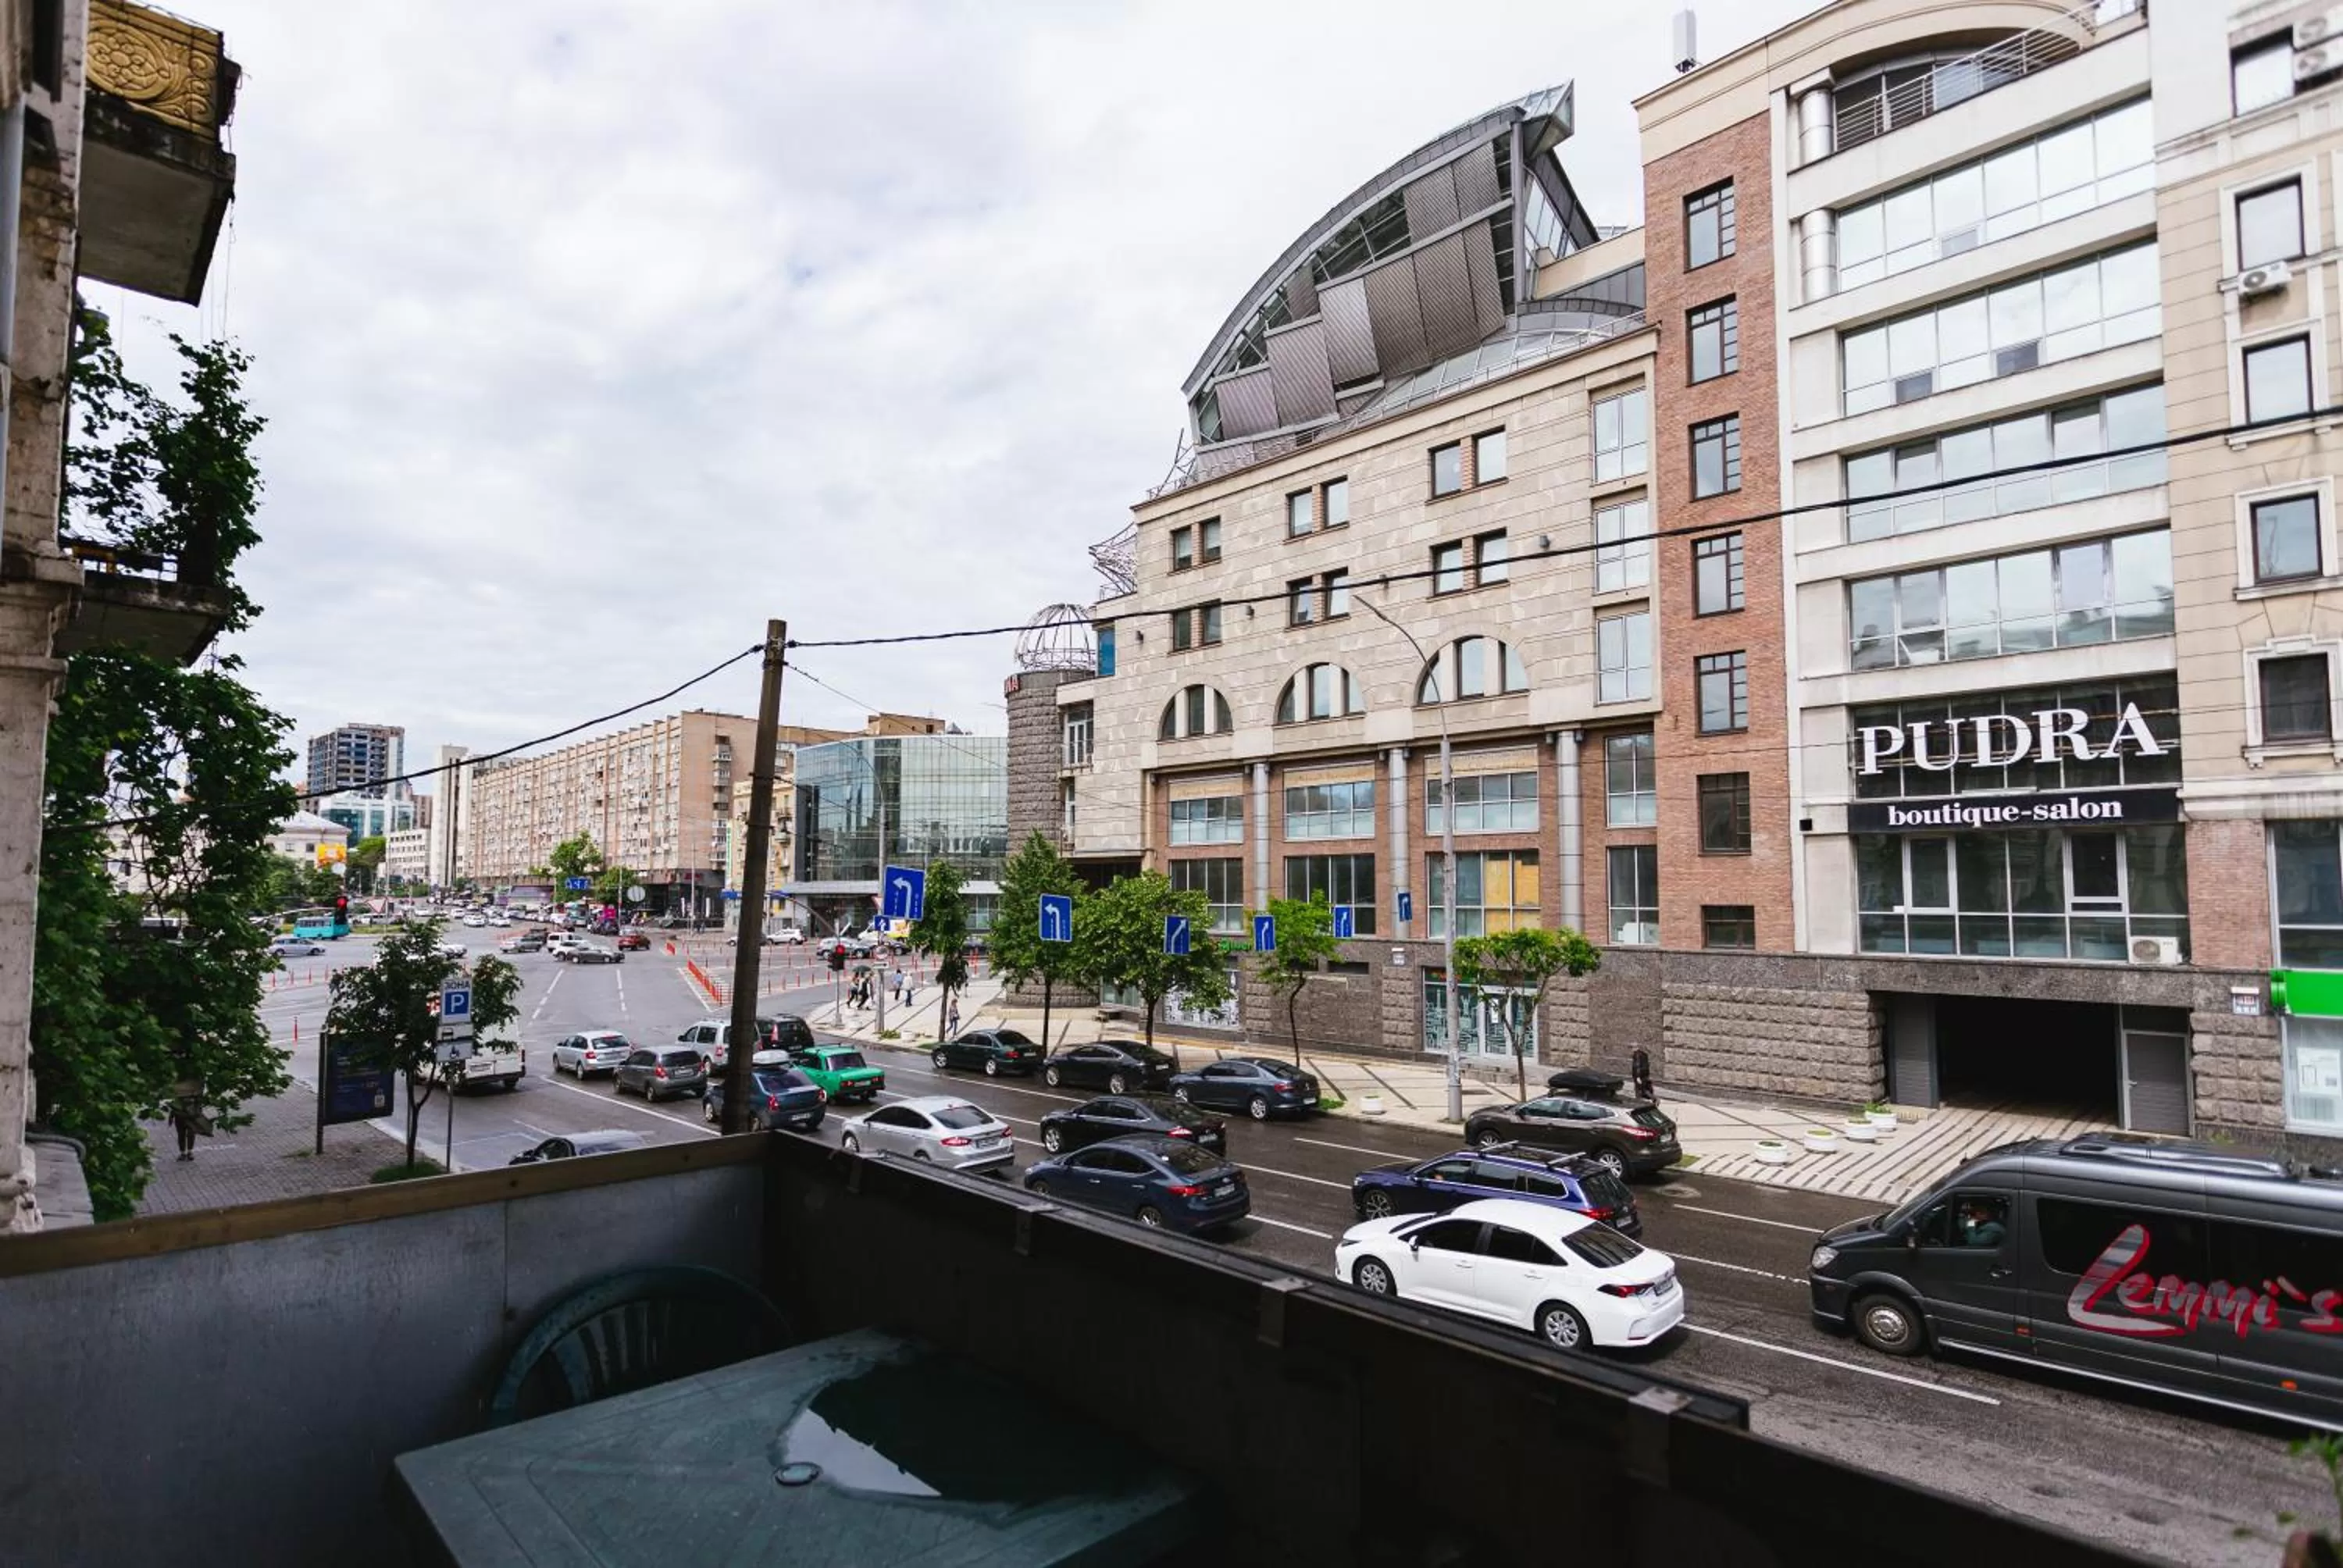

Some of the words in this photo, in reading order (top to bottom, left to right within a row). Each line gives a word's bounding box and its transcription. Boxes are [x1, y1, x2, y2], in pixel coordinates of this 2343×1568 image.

[1858, 701, 2169, 775] PUDRA
[1888, 796, 2124, 828] boutique-salon
[444, 981, 471, 990] ЗОНА
[451, 994, 465, 1013] P
